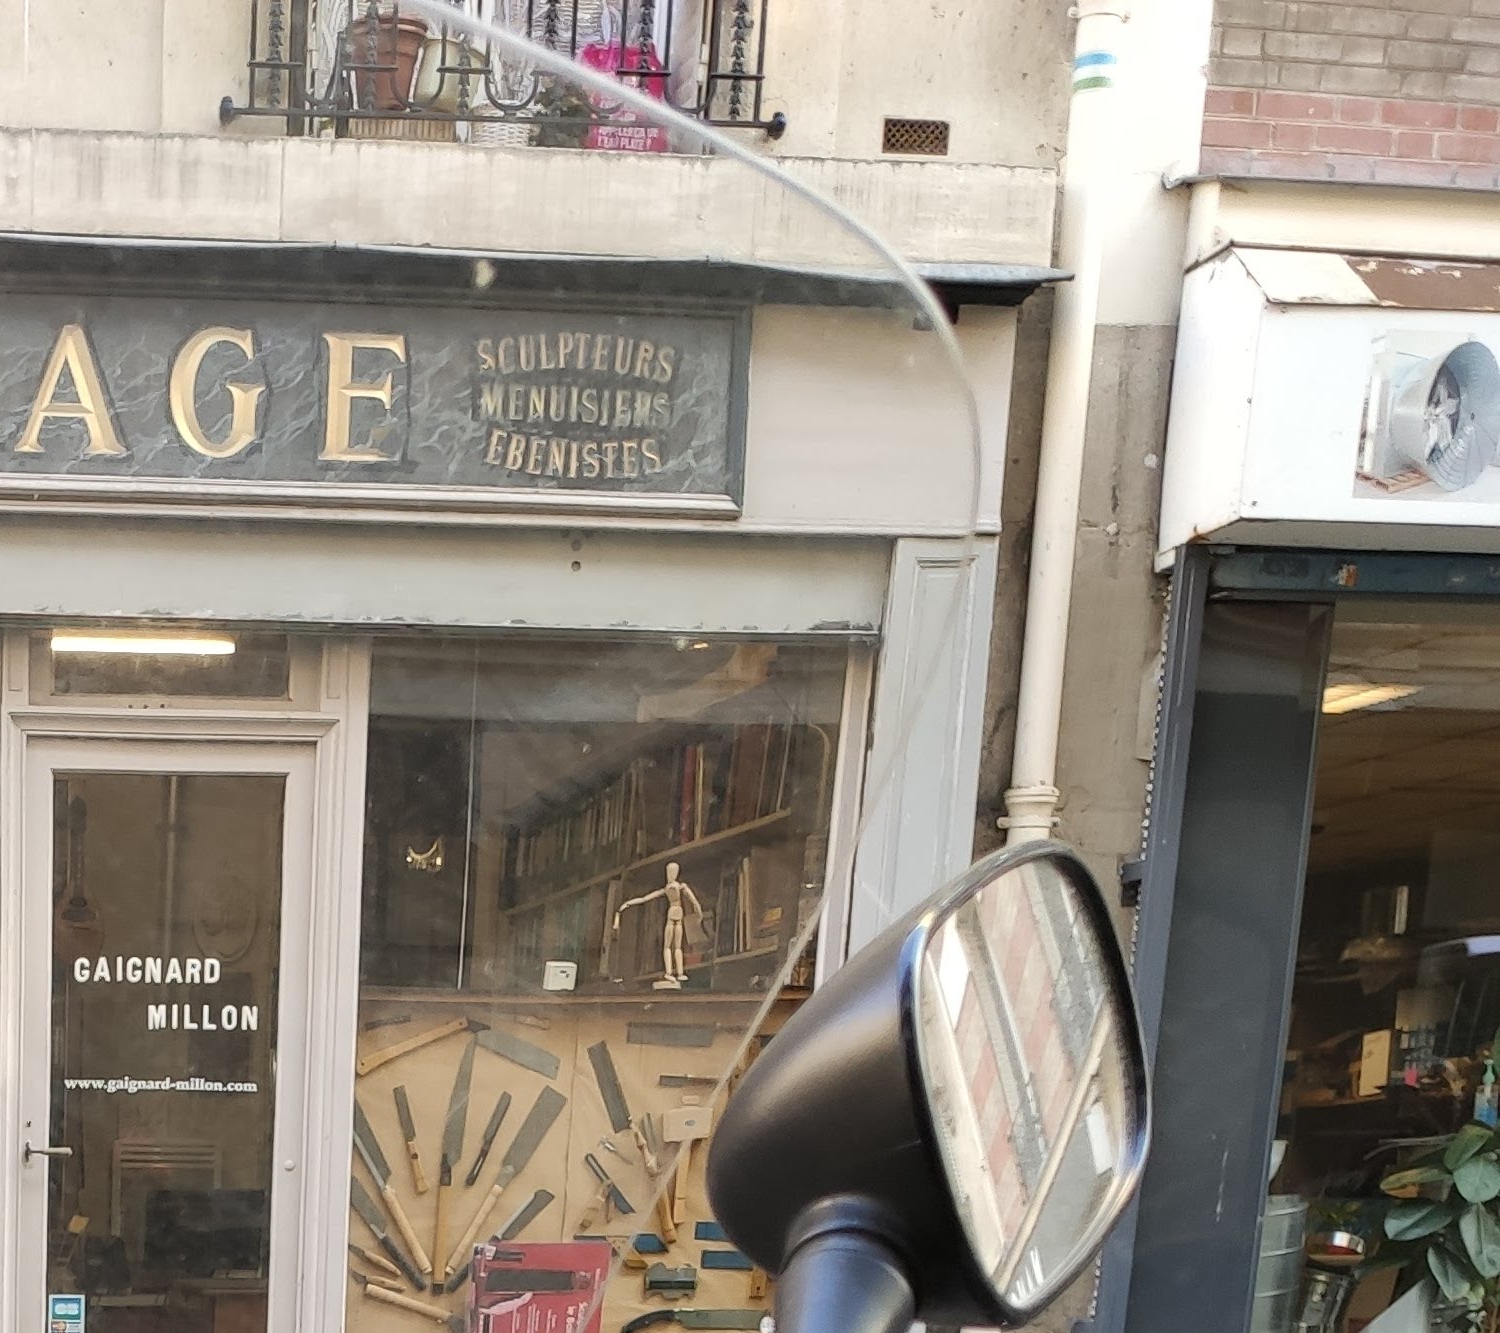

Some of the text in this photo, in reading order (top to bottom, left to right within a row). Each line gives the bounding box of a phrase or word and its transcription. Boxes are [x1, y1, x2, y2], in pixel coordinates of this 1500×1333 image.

[476, 331, 676, 384] SCULPTEURS
[484, 428, 663, 480] EBENISTES
[73, 955, 222, 984] GAIGNARD
[147, 1003, 260, 1031] MILLON
[64, 1076, 259, 1093] www.gaignard-millon.com
